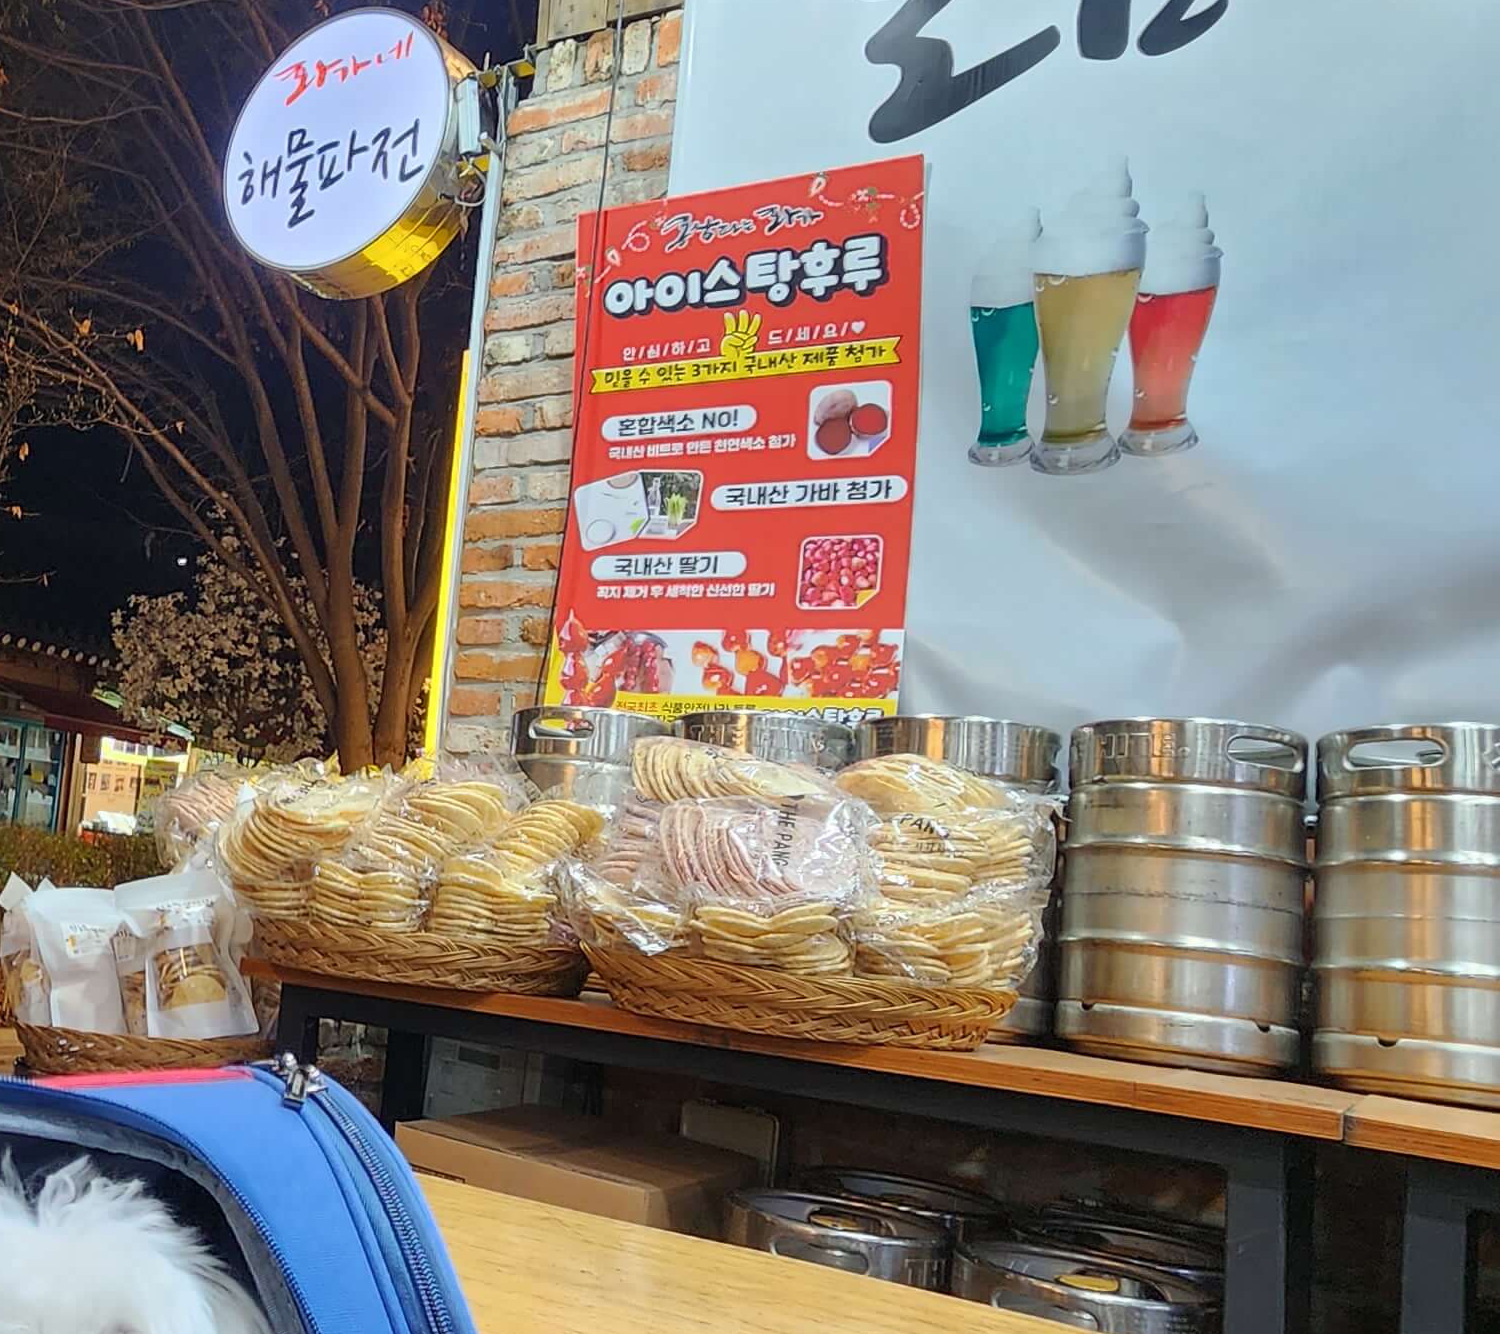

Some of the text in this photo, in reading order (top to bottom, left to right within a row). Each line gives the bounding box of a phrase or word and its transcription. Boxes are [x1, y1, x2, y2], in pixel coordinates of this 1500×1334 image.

[237, 117, 425, 229] 해물파전
[604, 235, 886, 317] 아이스탕후루
[604, 344, 887, 389] 믿을 수 있는 3가지 국내산 제품 첨가
[617, 409, 739, 437] 혼합색소 NO!
[608, 446, 646, 460] 국내산
[646, 442, 685, 459] 비트로
[767, 433, 797, 450] 첨가
[725, 479, 893, 507] 국내산 가바 첨가
[613, 555, 719, 577] 국내산 딸기
[747, 582, 776, 597] 딸기
[778, 801, 799, 829] THE
